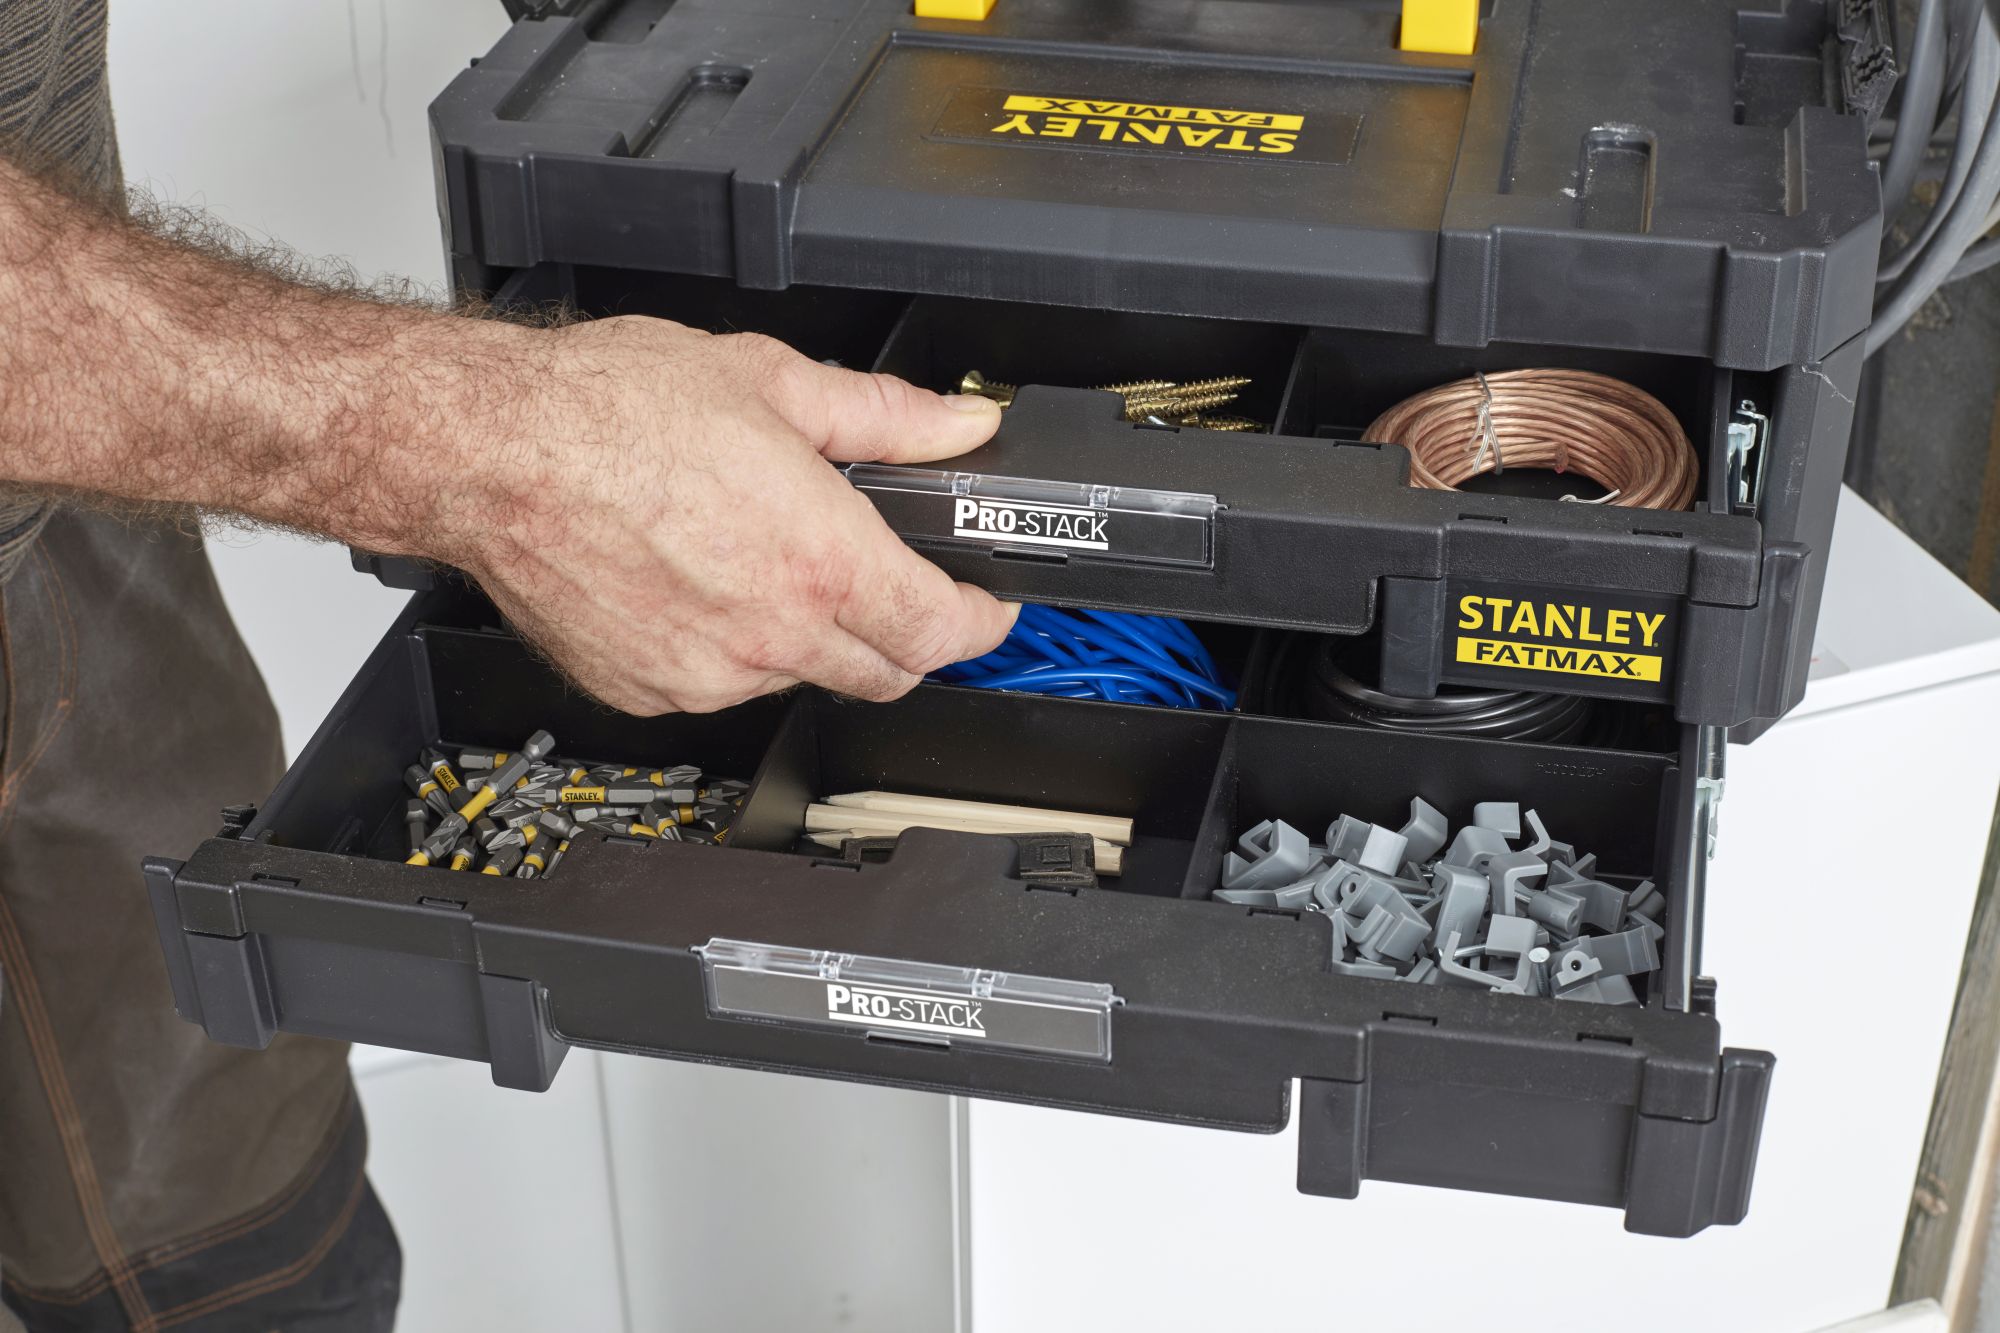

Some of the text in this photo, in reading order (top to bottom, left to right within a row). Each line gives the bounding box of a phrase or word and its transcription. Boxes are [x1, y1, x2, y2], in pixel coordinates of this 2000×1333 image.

[1040, 100, 1274, 126] FATMAX
[991, 114, 1299, 154] STANLEY
[1458, 595, 1667, 648] STANLEY
[1475, 642, 1637, 677] FATMAX
